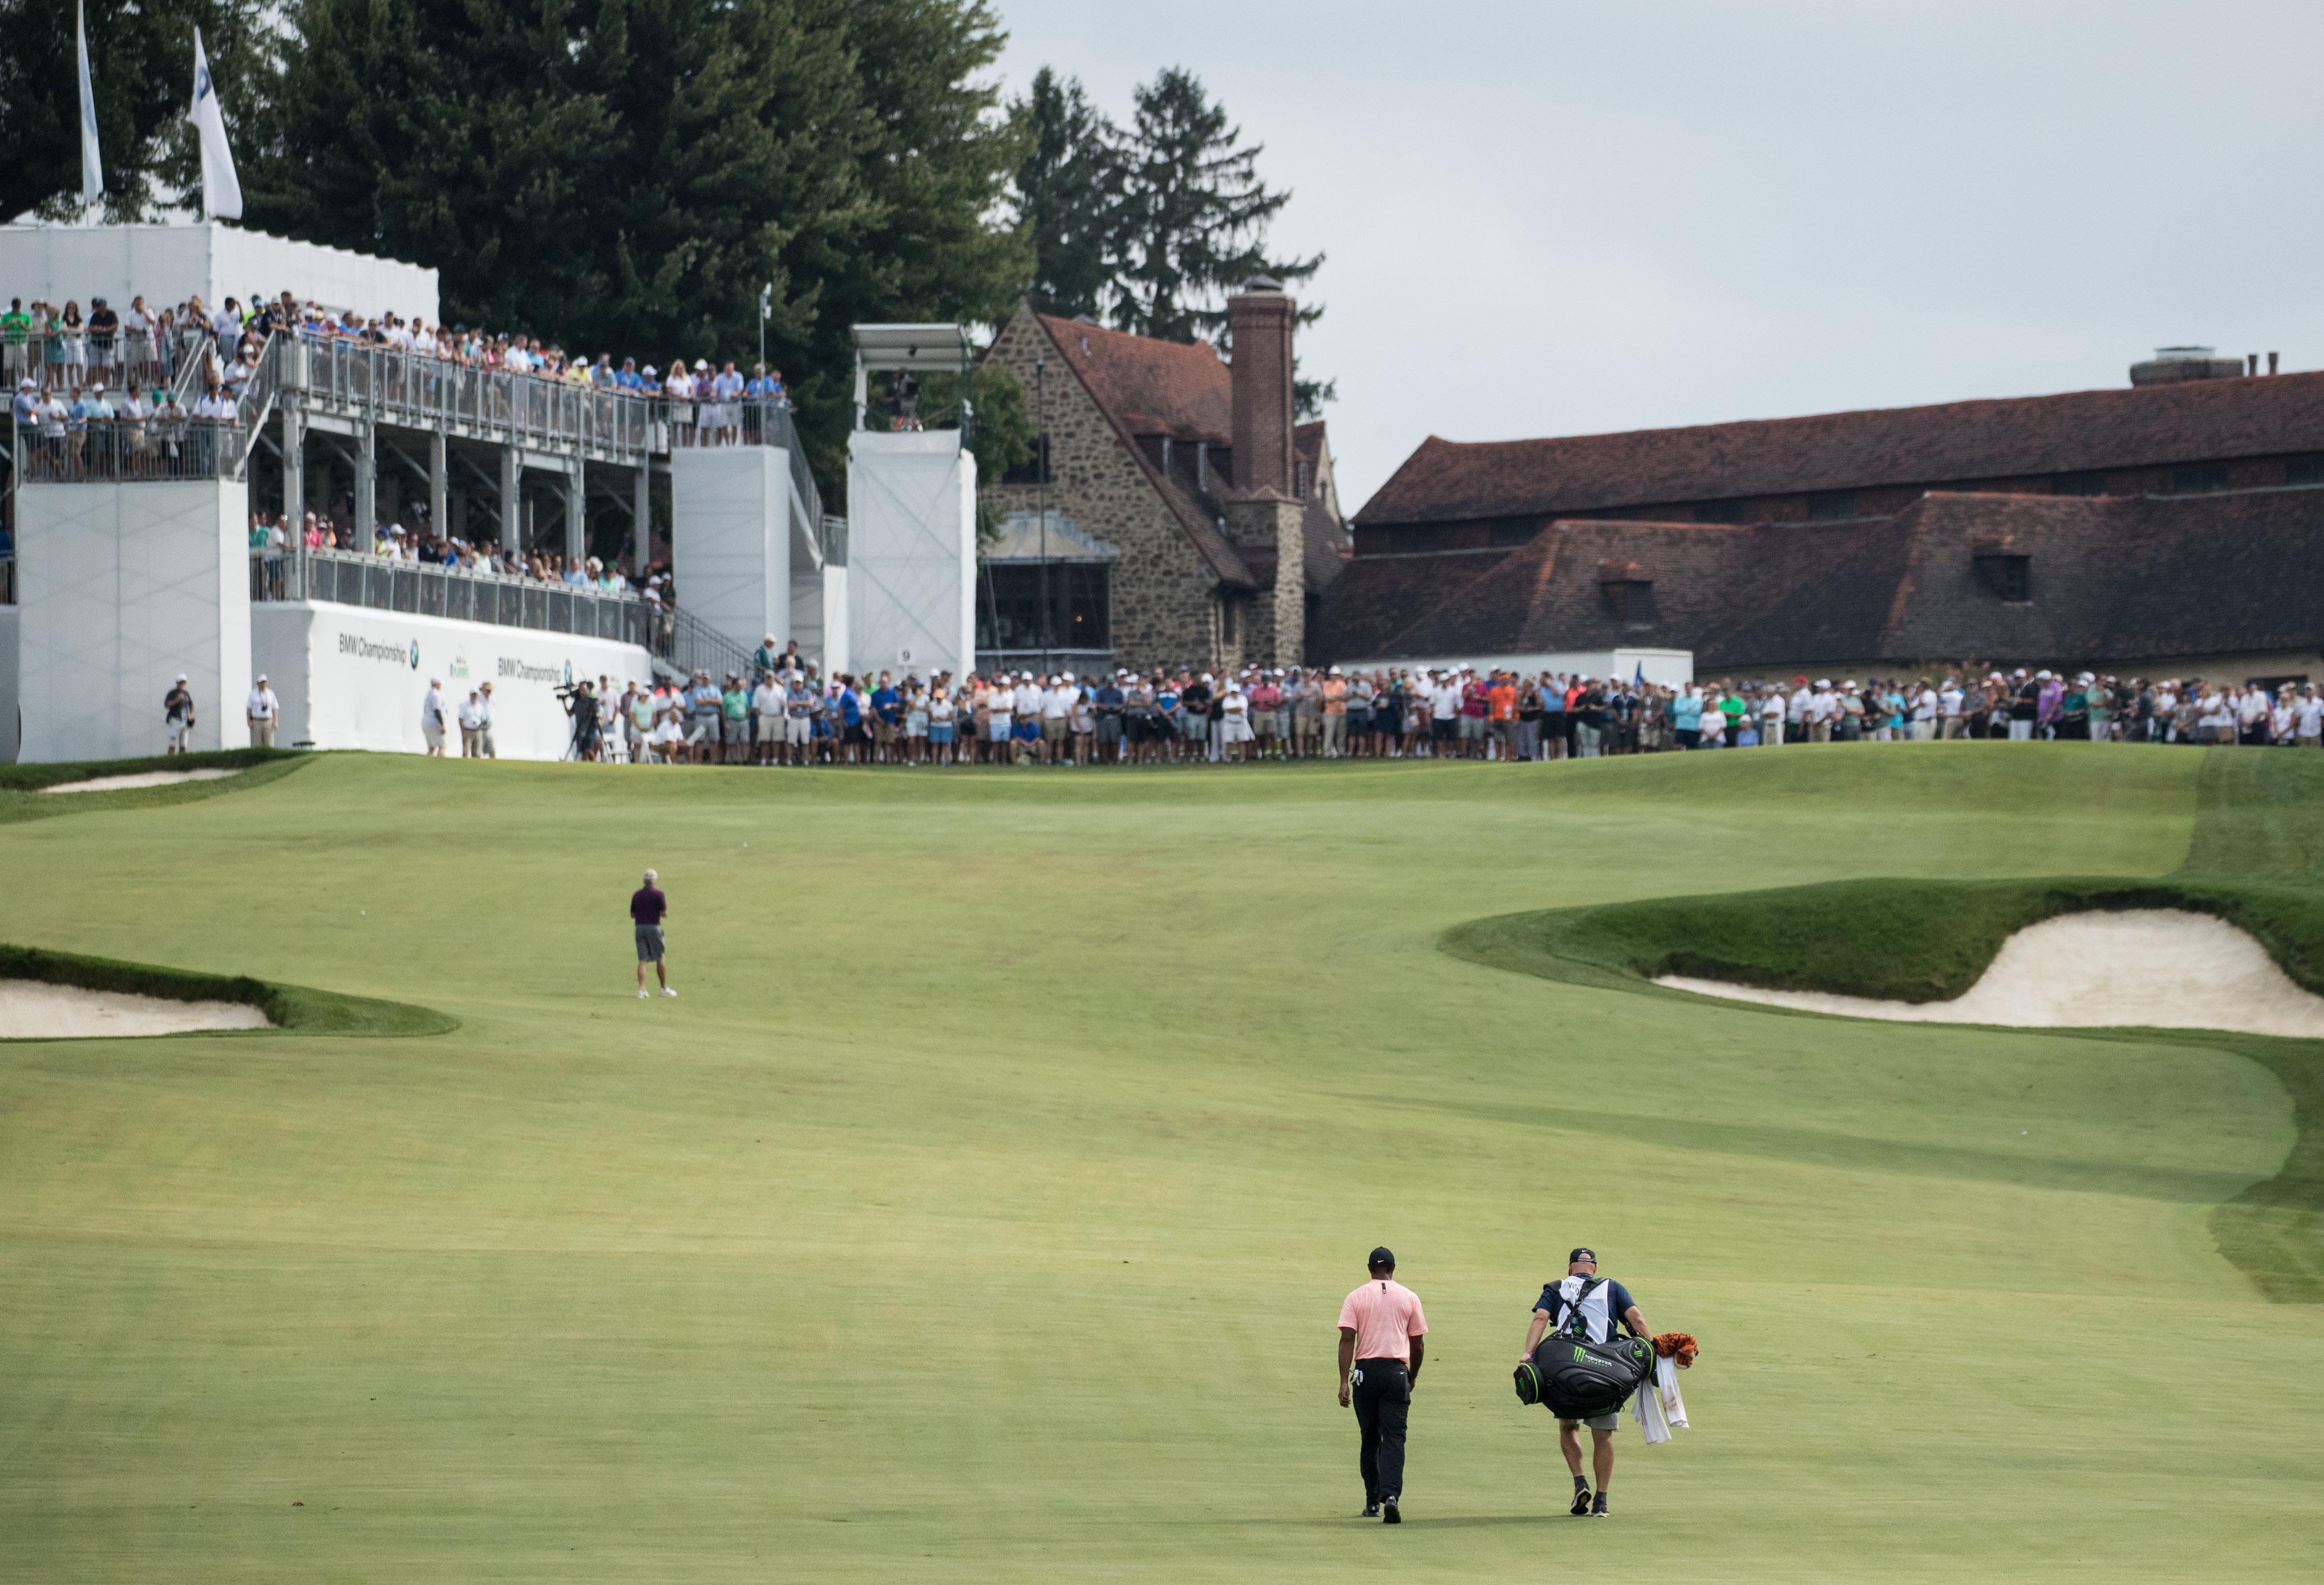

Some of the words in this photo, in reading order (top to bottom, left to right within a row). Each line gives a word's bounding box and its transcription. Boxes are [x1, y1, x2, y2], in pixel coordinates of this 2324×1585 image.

[339, 632, 358, 655] BMW
[359, 636, 406, 667] Championship
[902, 649, 910, 662] 9
[499, 657, 516, 677] BMW
[517, 659, 561, 687] Championship
[1585, 1354, 1612, 1367] MONSTER
